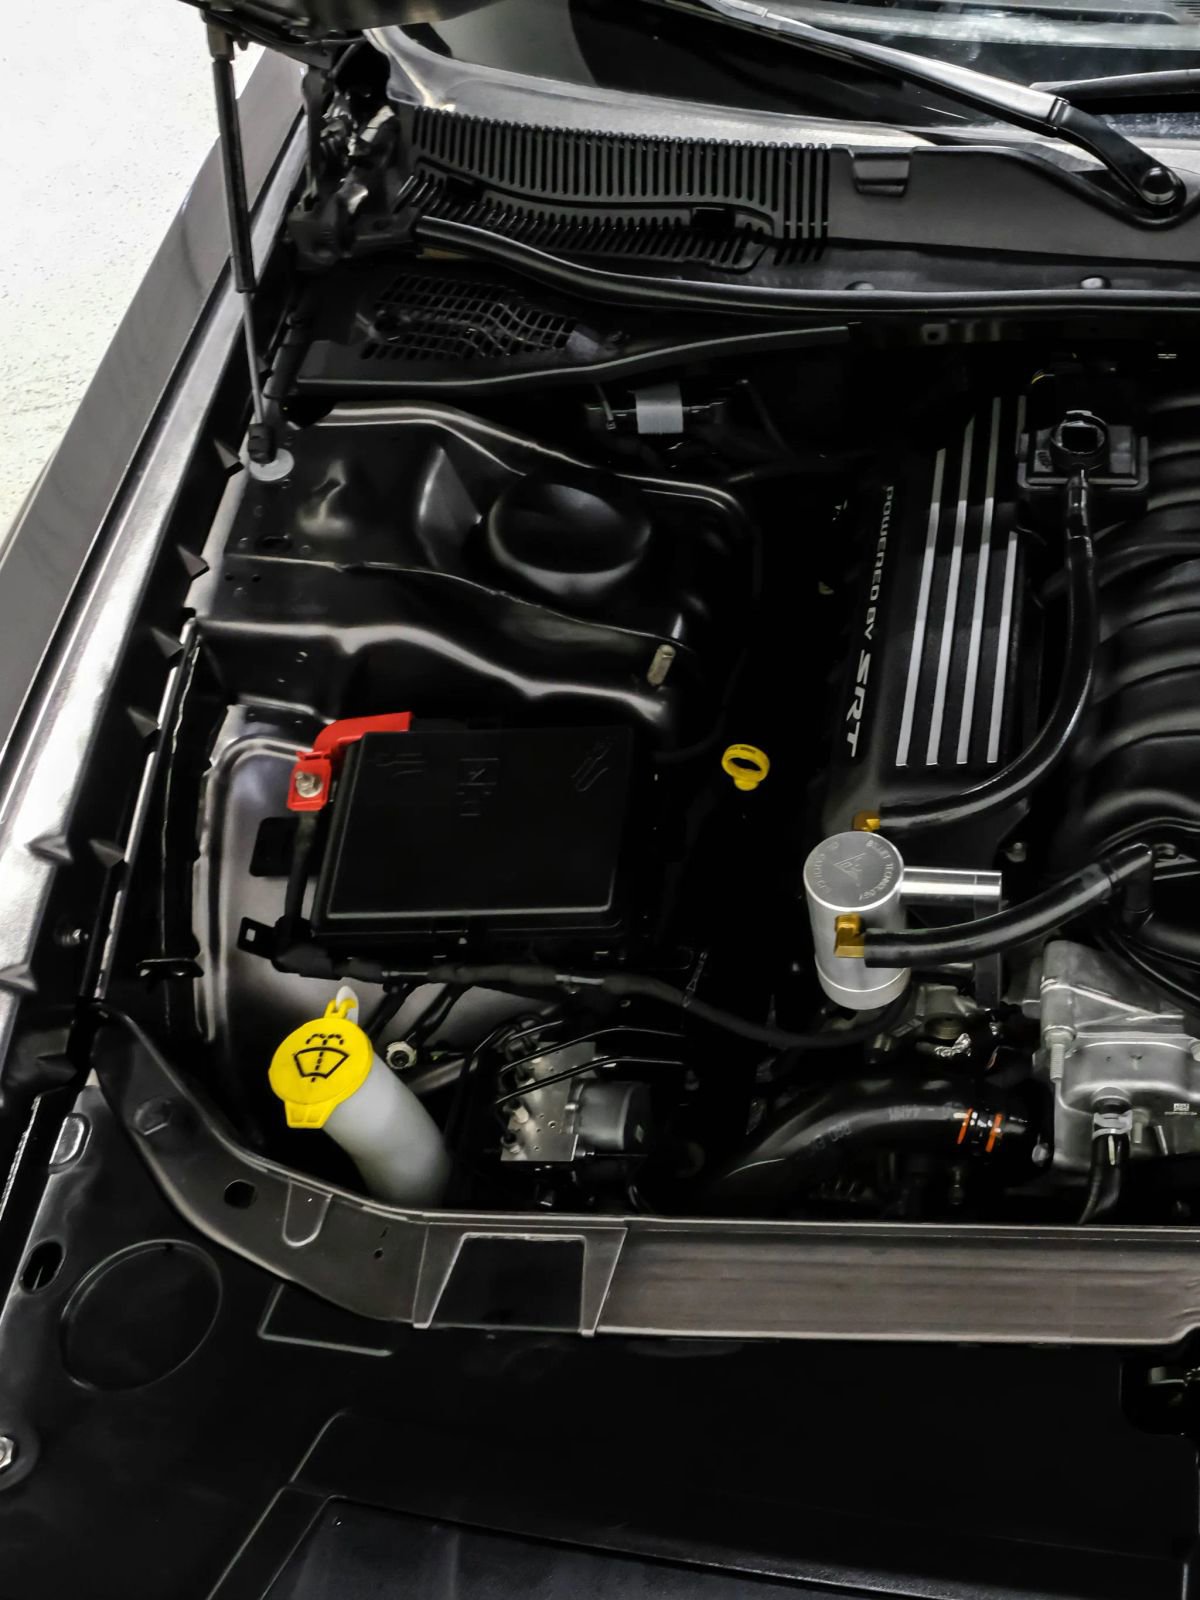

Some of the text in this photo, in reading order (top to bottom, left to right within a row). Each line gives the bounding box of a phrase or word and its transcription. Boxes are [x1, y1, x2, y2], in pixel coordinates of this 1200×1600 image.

[846, 485, 896, 758] POWERED BY SRT
